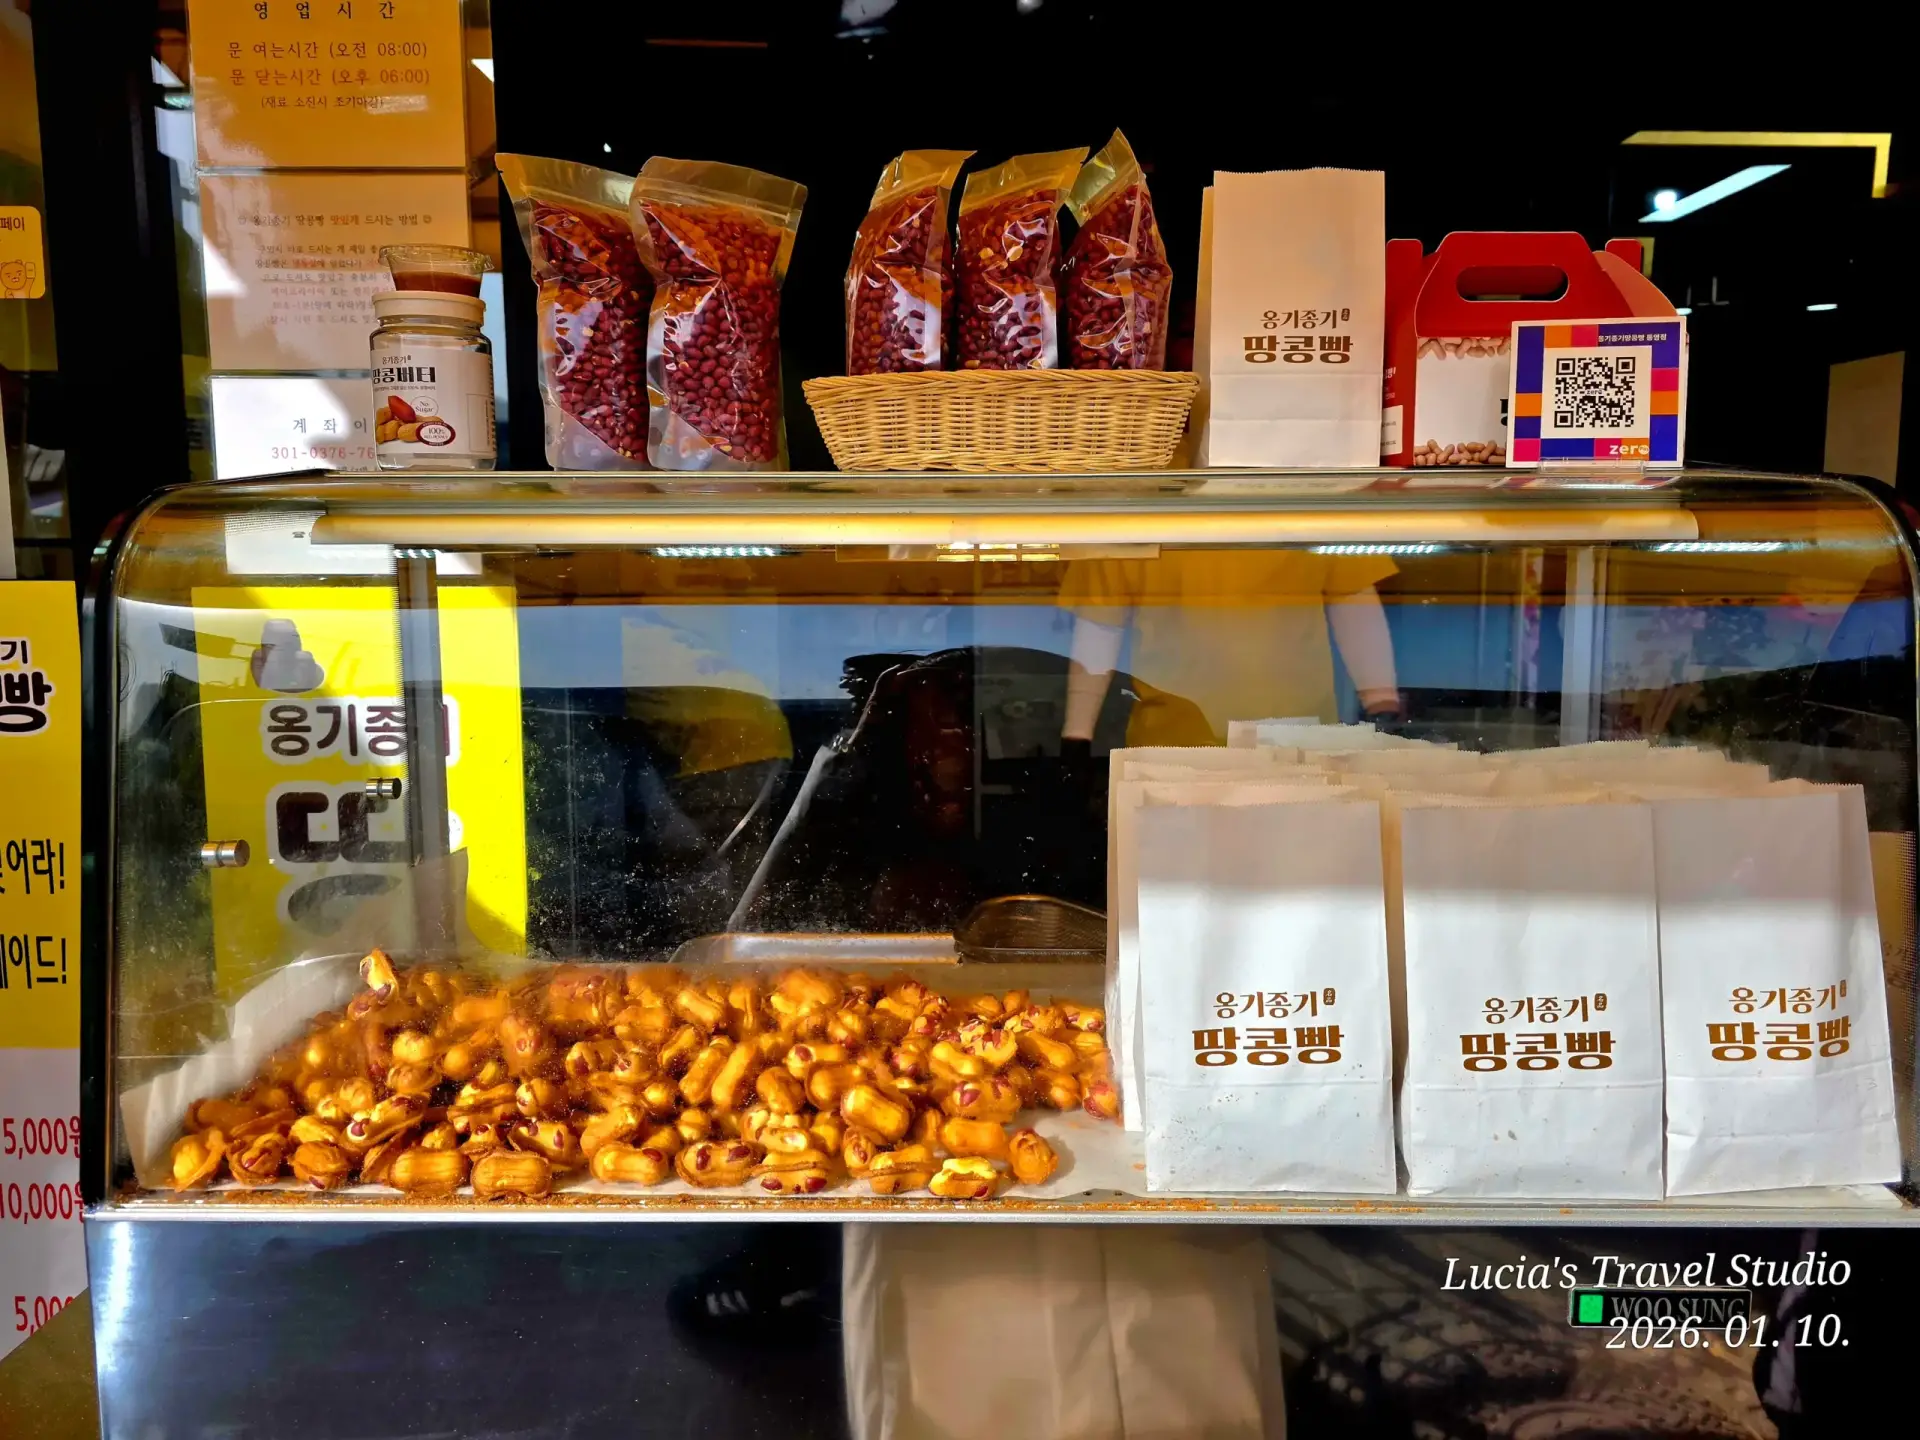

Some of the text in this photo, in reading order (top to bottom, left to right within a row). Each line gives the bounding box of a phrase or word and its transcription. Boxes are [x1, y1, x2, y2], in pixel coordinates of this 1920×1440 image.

[227, 41, 427, 59] 문 여는시간 (오전 08:00)
[229, 69, 430, 86] 문 닫는시간 (오후 06:00)
[261, 96, 384, 109] (재료 소진시 조기마감)
[330, 215, 359, 226] 맛있게
[364, 215, 394, 226] 드시는
[398, 214, 418, 226] 방법
[1260, 309, 1337, 329] 옹기종기
[1243, 335, 1353, 364] 땅콩빵
[266, 703, 451, 757] 옹기종
[0, 838, 65, 895] 어라!
[1213, 990, 1318, 1019] 옹기종기
[1481, 996, 1589, 1025] 옹기종기
[1728, 984, 1836, 1014] 옹기종기
[1191, 1024, 1345, 1067] 땅콩빵
[1459, 1031, 1617, 1072] 땅콩빵
[1705, 1015, 1852, 1062] 땅콩빵
[1611, 1297, 1745, 1323] WOO SUNG
